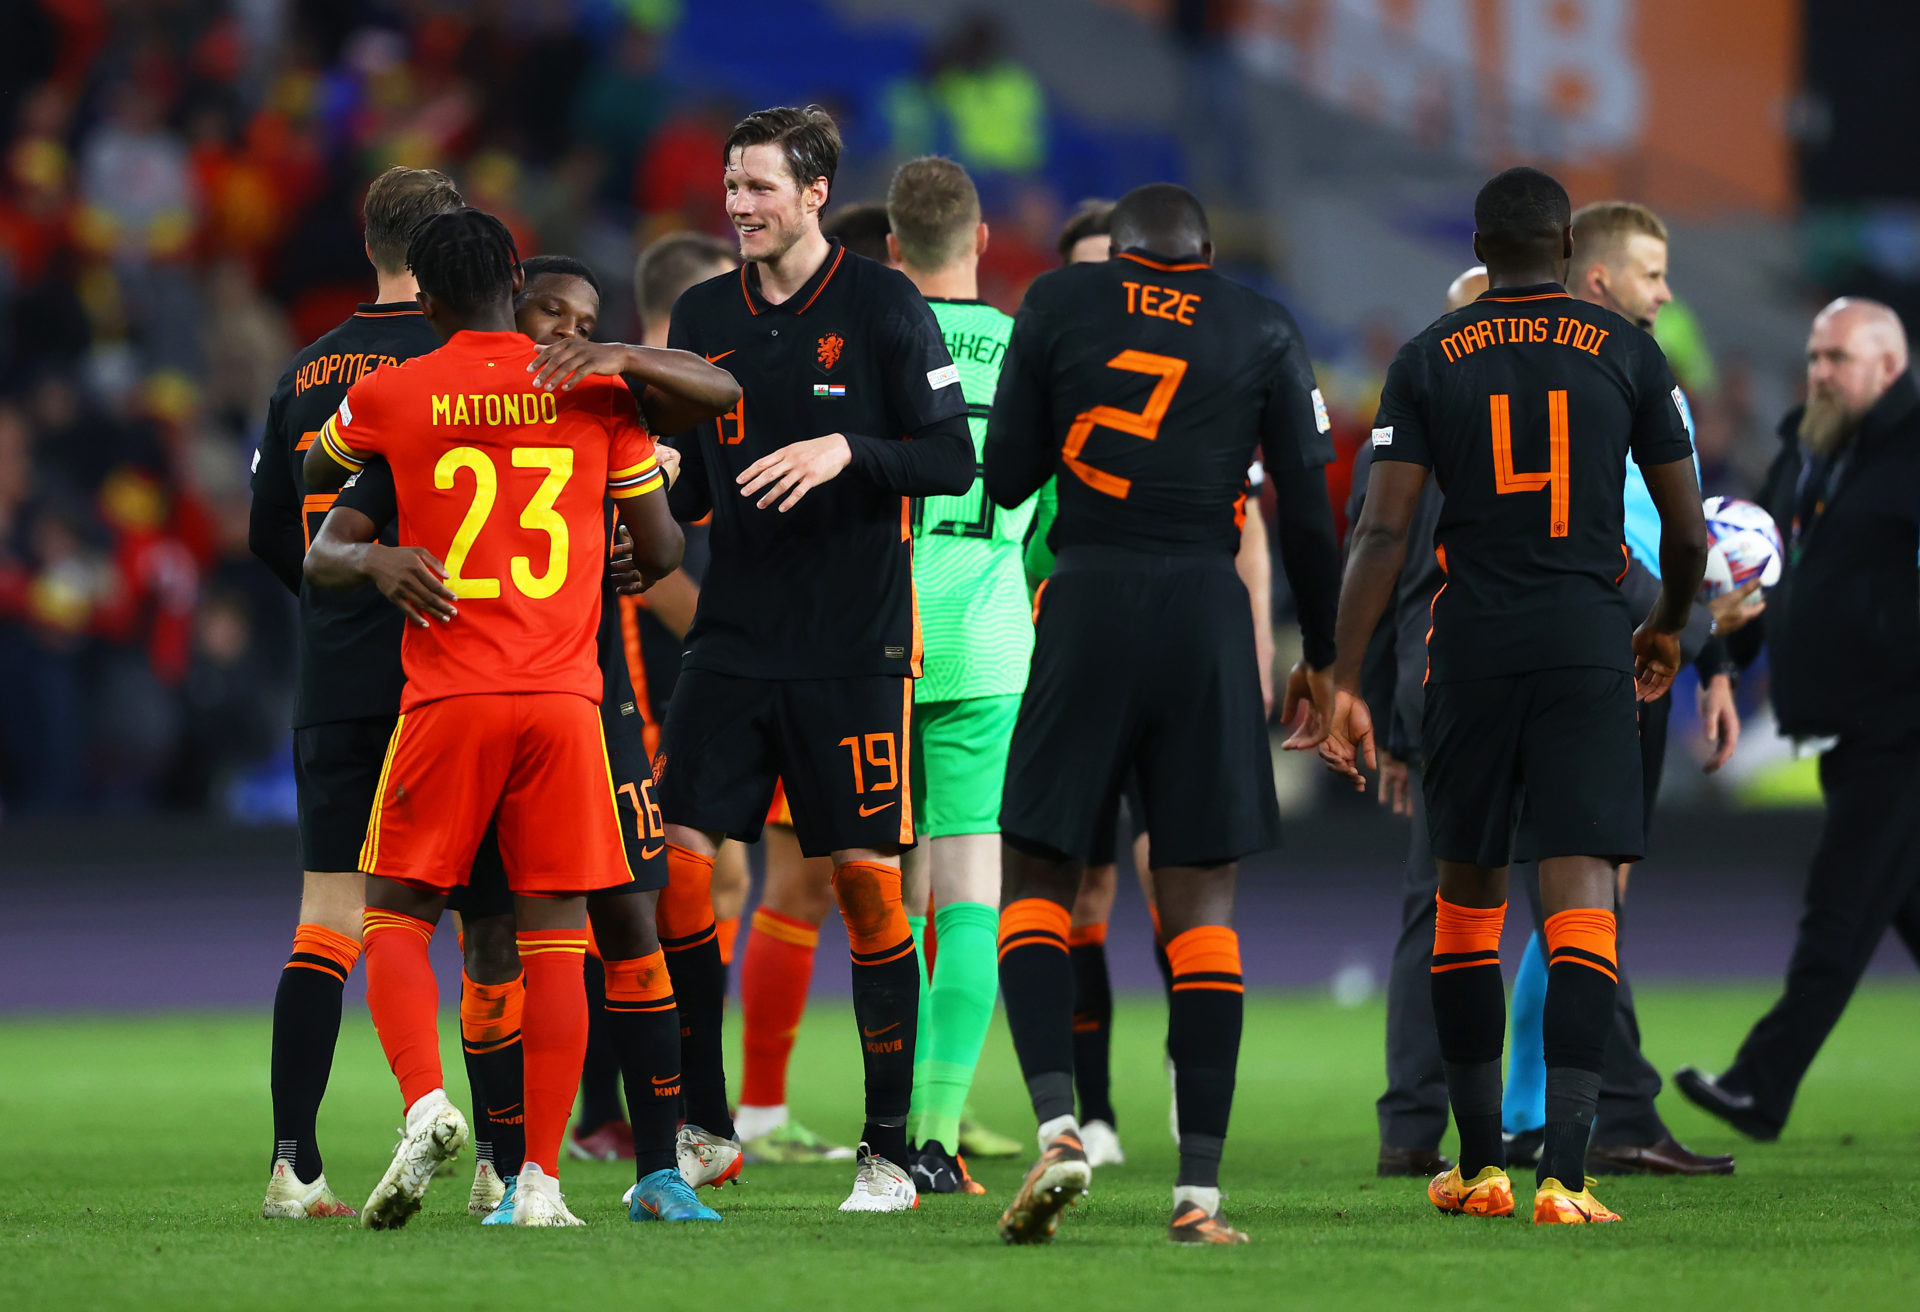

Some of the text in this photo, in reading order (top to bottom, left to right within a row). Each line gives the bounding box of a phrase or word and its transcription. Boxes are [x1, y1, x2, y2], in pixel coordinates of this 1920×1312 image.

[1121, 281, 1202, 326] TEZE
[1439, 316, 1610, 363] MARTINS INDI
[295, 353, 408, 398] KOOPME
[431, 392, 558, 426] MATONDO
[1061, 349, 1189, 499] 2
[1489, 389, 1570, 538] 4
[433, 446, 575, 600] 23
[838, 732, 899, 794] 19
[616, 778, 665, 840] 16
[866, 1038, 903, 1053] KNVB
[654, 1084, 681, 1097] KNV
